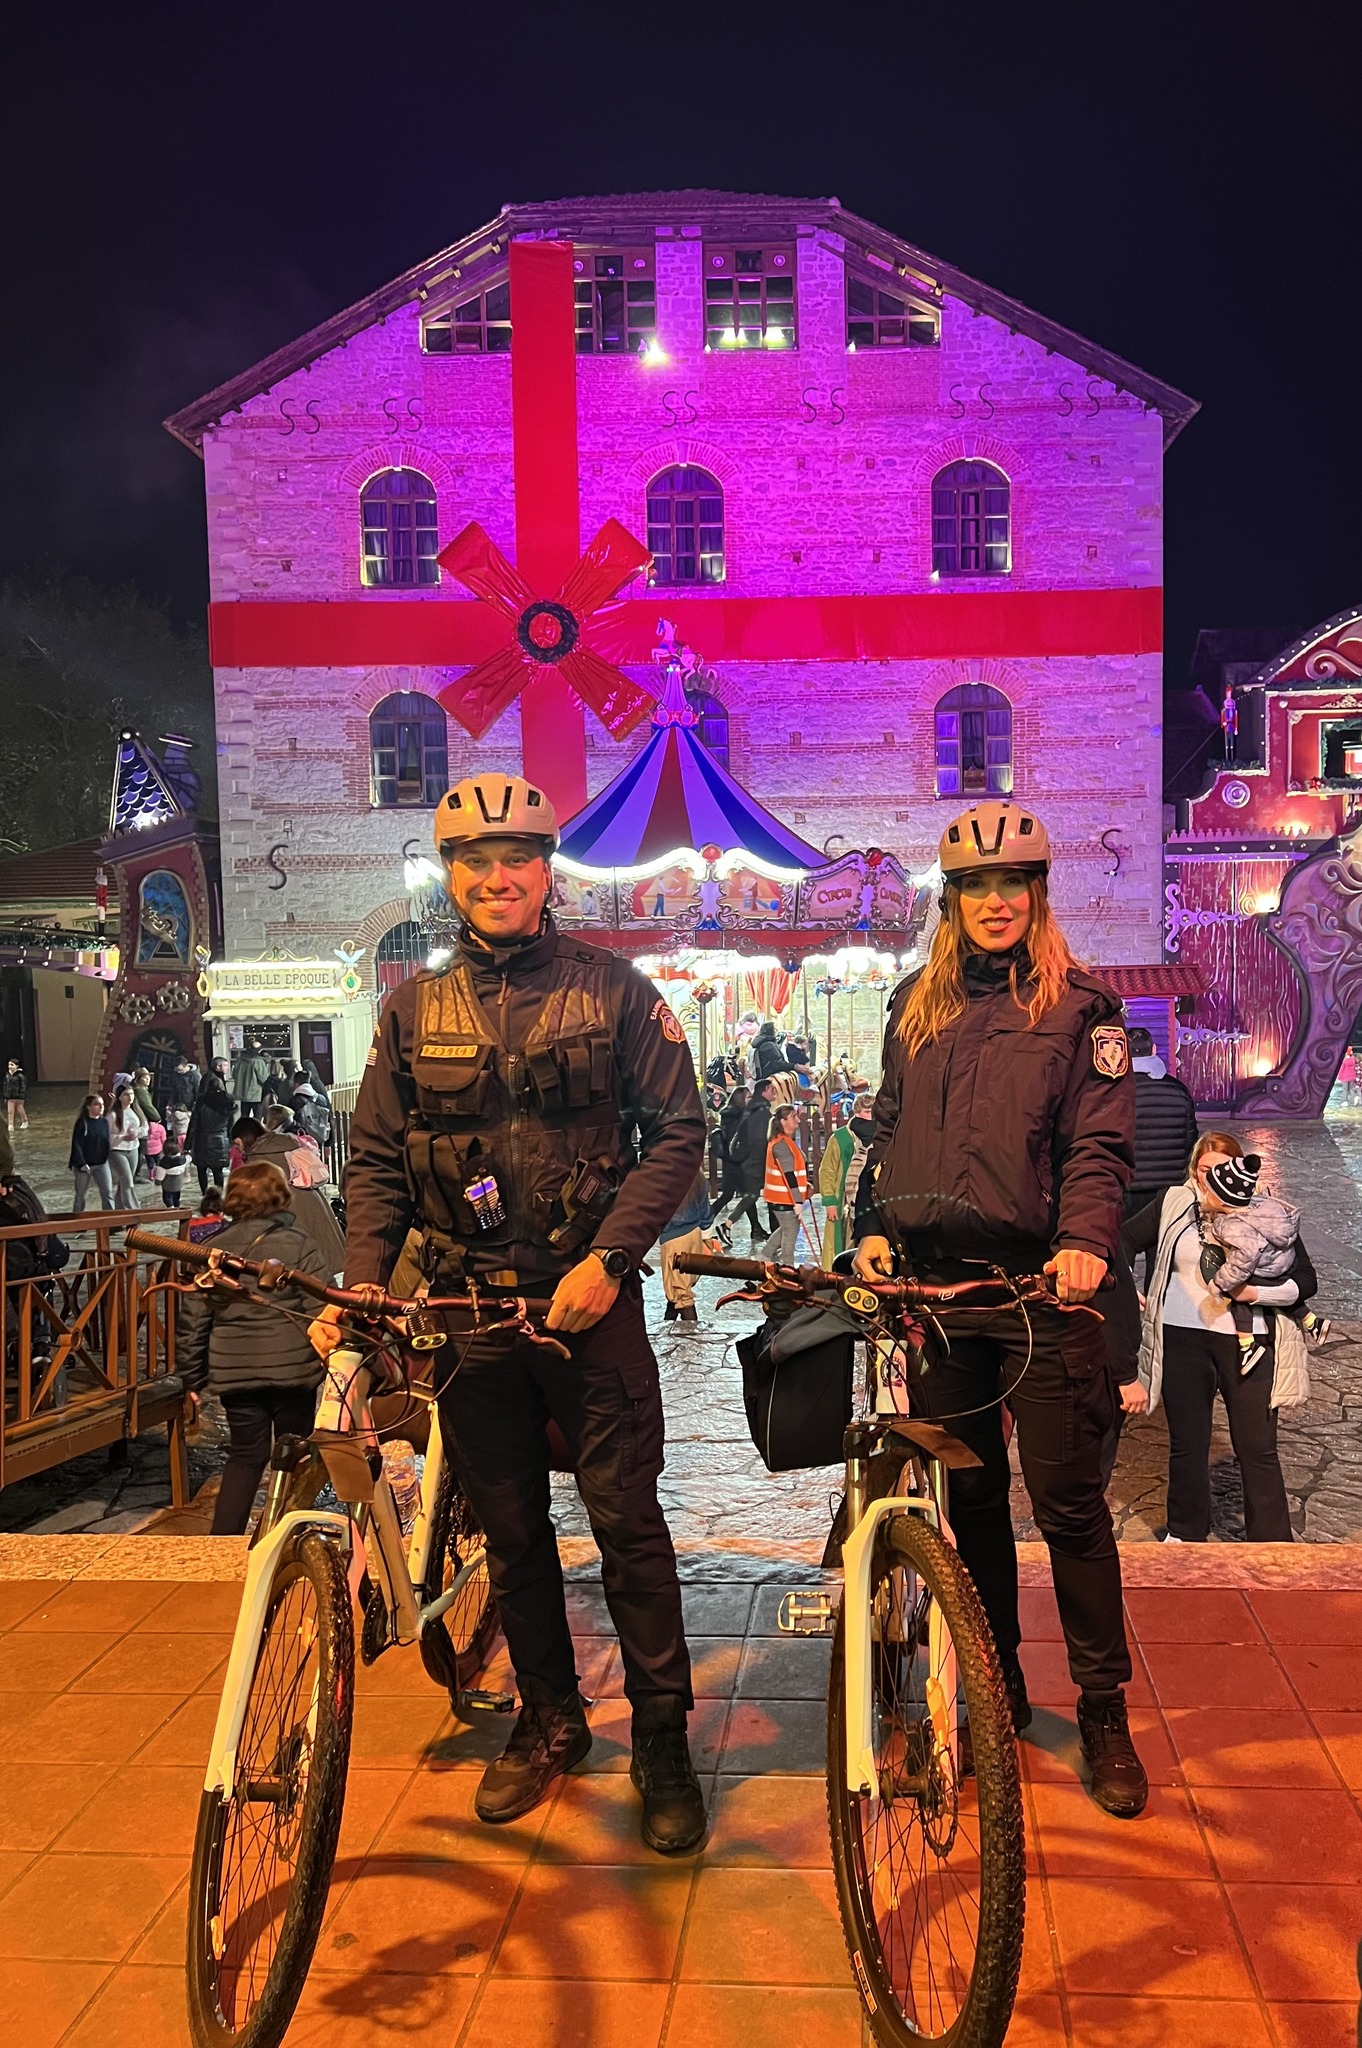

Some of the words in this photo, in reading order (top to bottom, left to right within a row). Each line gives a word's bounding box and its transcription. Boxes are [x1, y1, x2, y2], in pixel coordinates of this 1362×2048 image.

[225, 975, 239, 986] LA
[244, 974, 281, 985] BELLE
[285, 973, 329, 985] EPOQUE
[426, 1047, 475, 1056] POLICE
